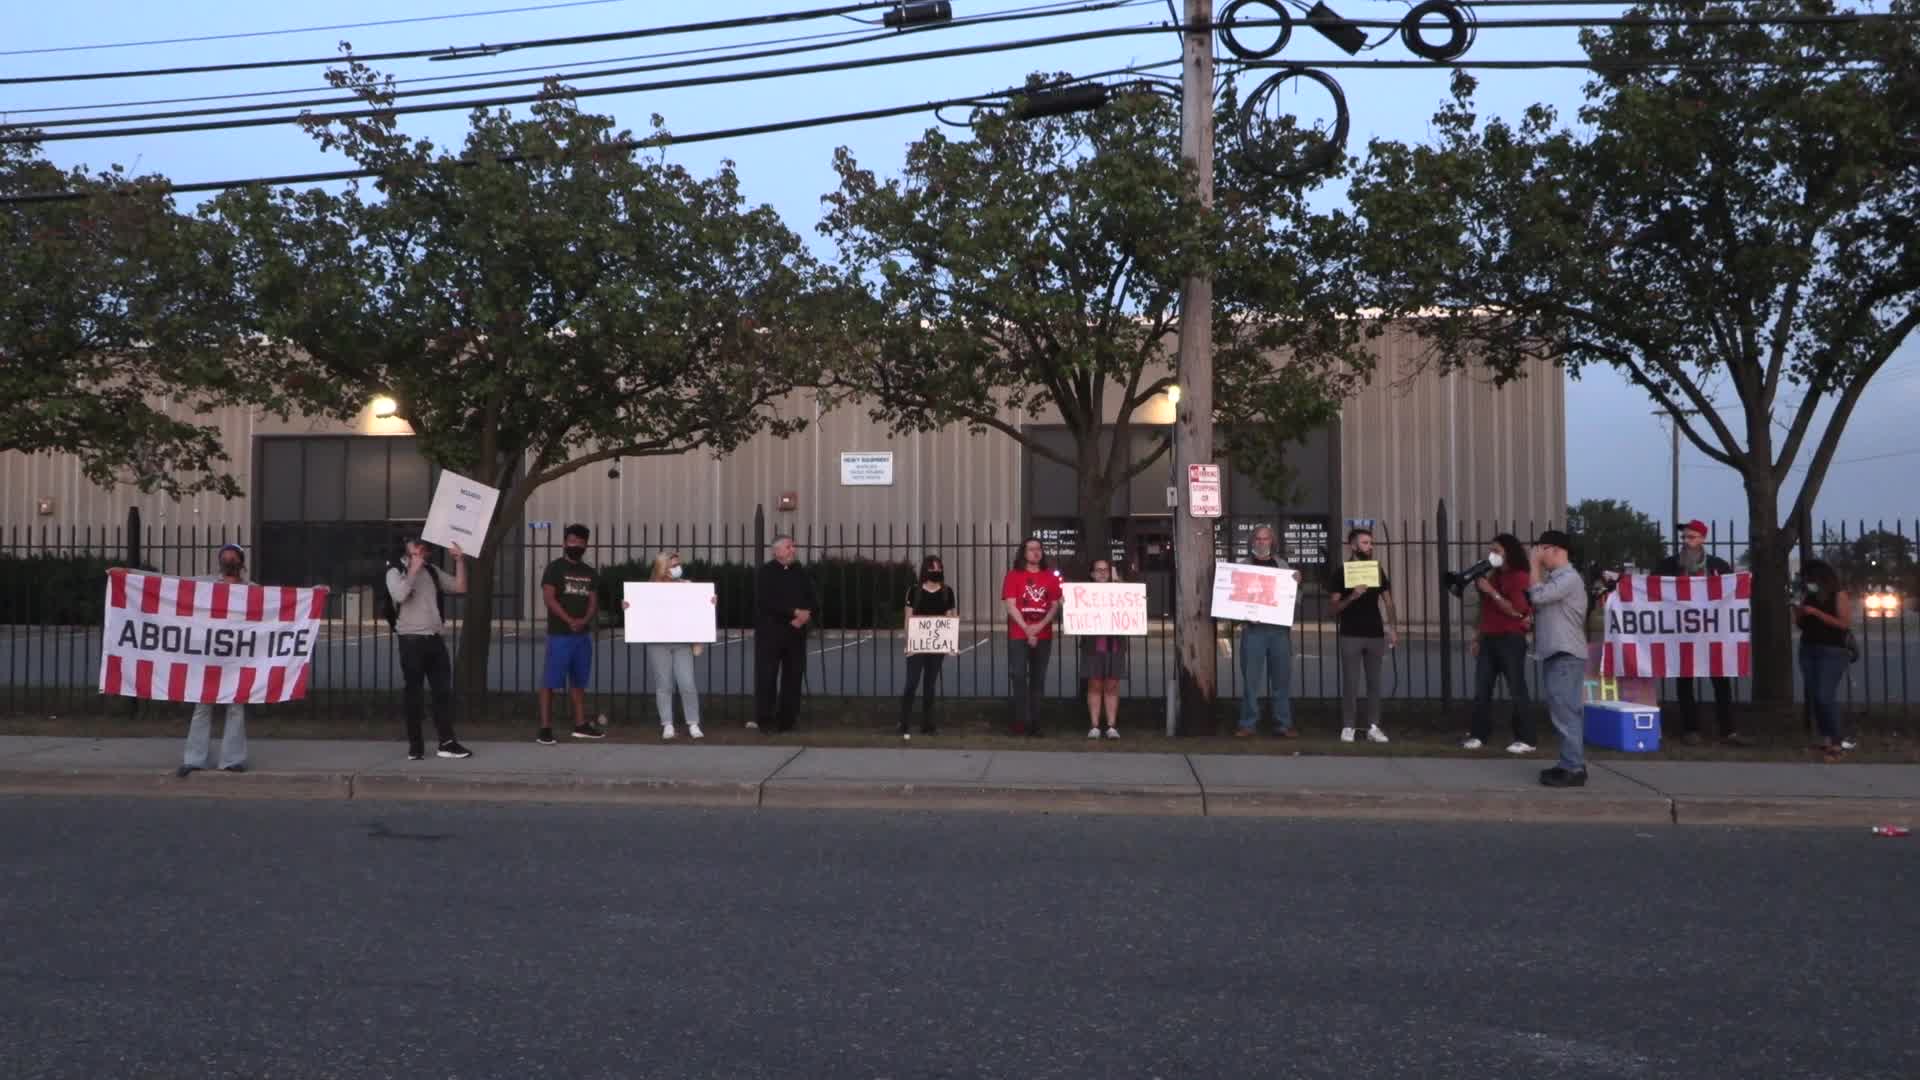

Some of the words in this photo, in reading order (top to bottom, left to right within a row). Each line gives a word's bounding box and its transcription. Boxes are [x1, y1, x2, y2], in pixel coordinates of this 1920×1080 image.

[1192, 505, 1219, 513] STANDING
[1073, 585, 1144, 609] RELEASE
[919, 620, 932, 630] NO
[935, 619, 952, 629] ONE
[1066, 612, 1102, 632] THEM
[1609, 608, 1719, 634] ABOLISH
[1729, 608, 1750, 633] IC
[118, 619, 256, 658] ABOLISH
[268, 629, 310, 658] ICE
[928, 629, 940, 639] IS
[909, 638, 956, 653] ILLEGAL
